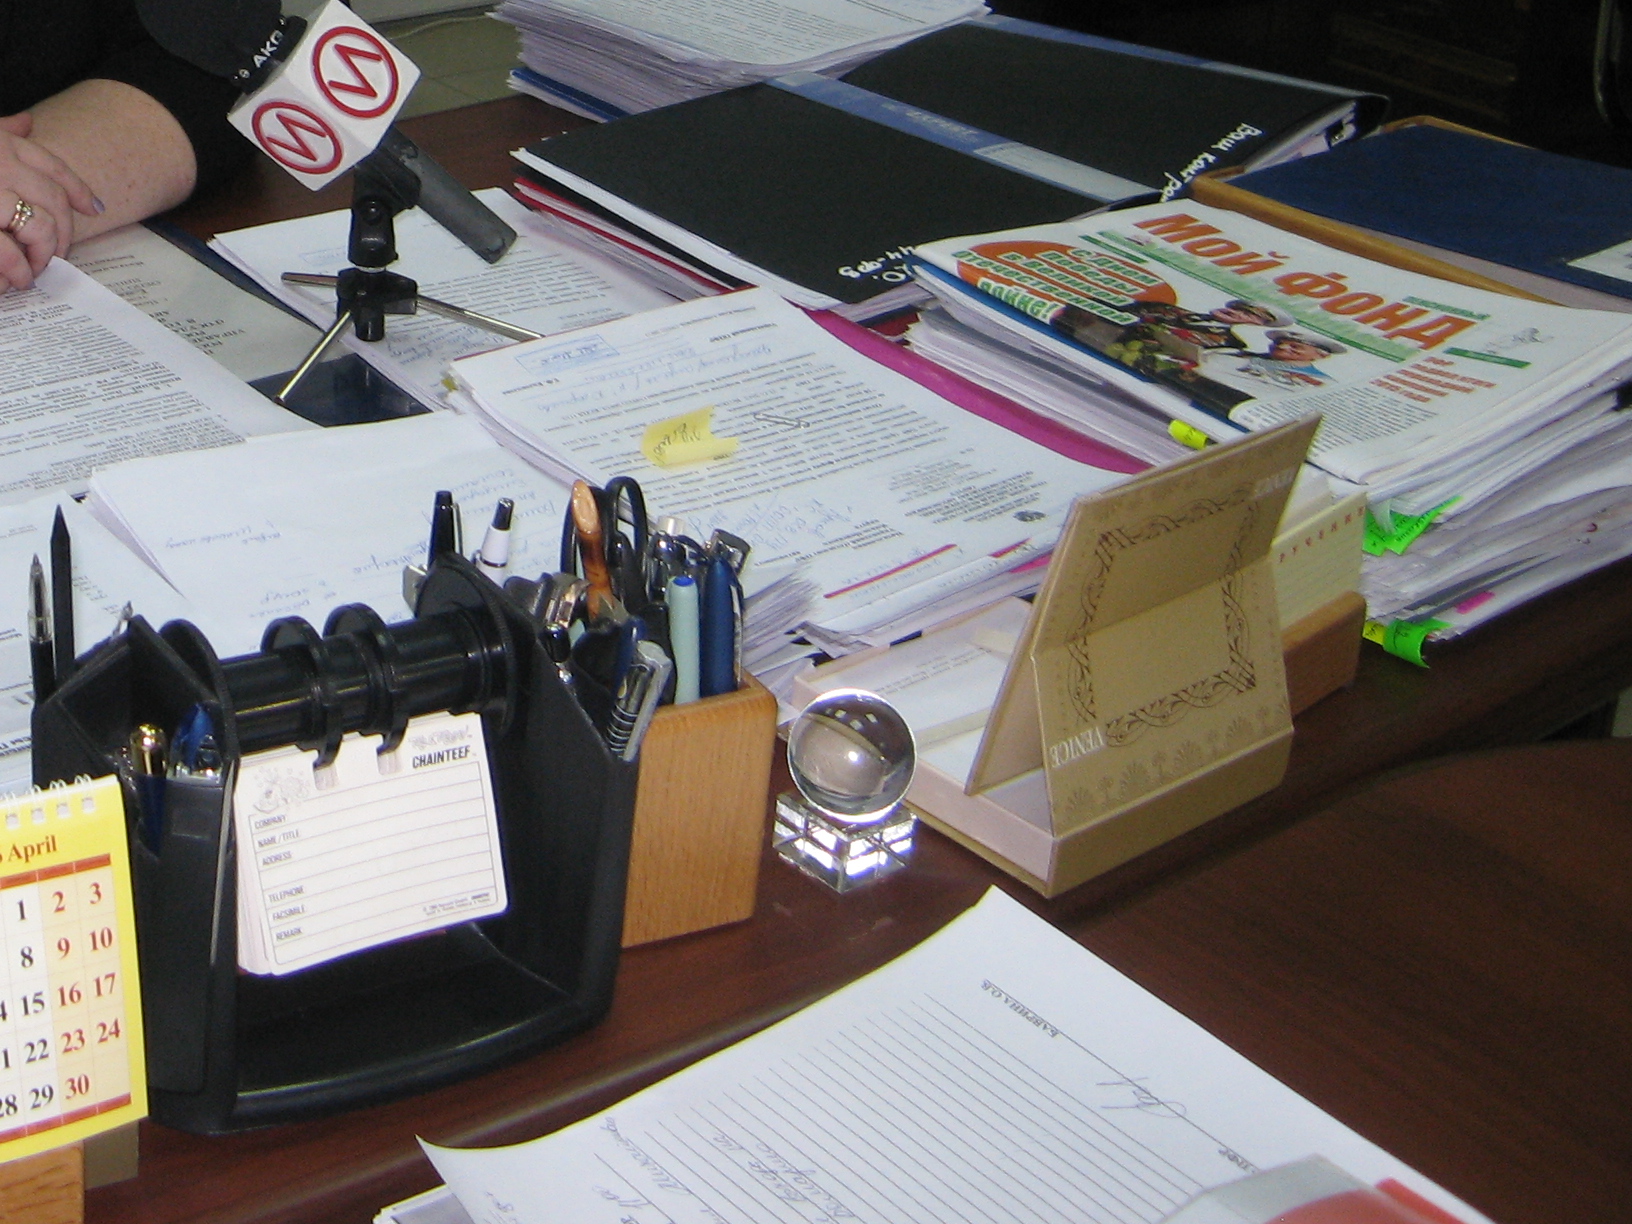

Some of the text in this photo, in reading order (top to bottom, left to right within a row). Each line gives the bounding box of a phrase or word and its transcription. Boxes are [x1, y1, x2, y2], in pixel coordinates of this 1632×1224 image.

[412, 745, 471, 769] CHAINTEEF
[8, 836, 57, 864] April
[18, 900, 25, 920] 1
[53, 891, 66, 912] 2
[90, 882, 102, 903] 3
[21, 946, 34, 968] 8
[57, 937, 70, 959] 9
[90, 927, 112, 951] 10
[20, 991, 46, 1016] 15
[58, 983, 81, 1007] 16
[93, 973, 116, 997] 17
[24, 1038, 50, 1063] 22
[61, 1029, 85, 1053] 23
[96, 1019, 120, 1044] 24
[29, 1084, 54, 1110] 29
[65, 1074, 89, 1099] 30
